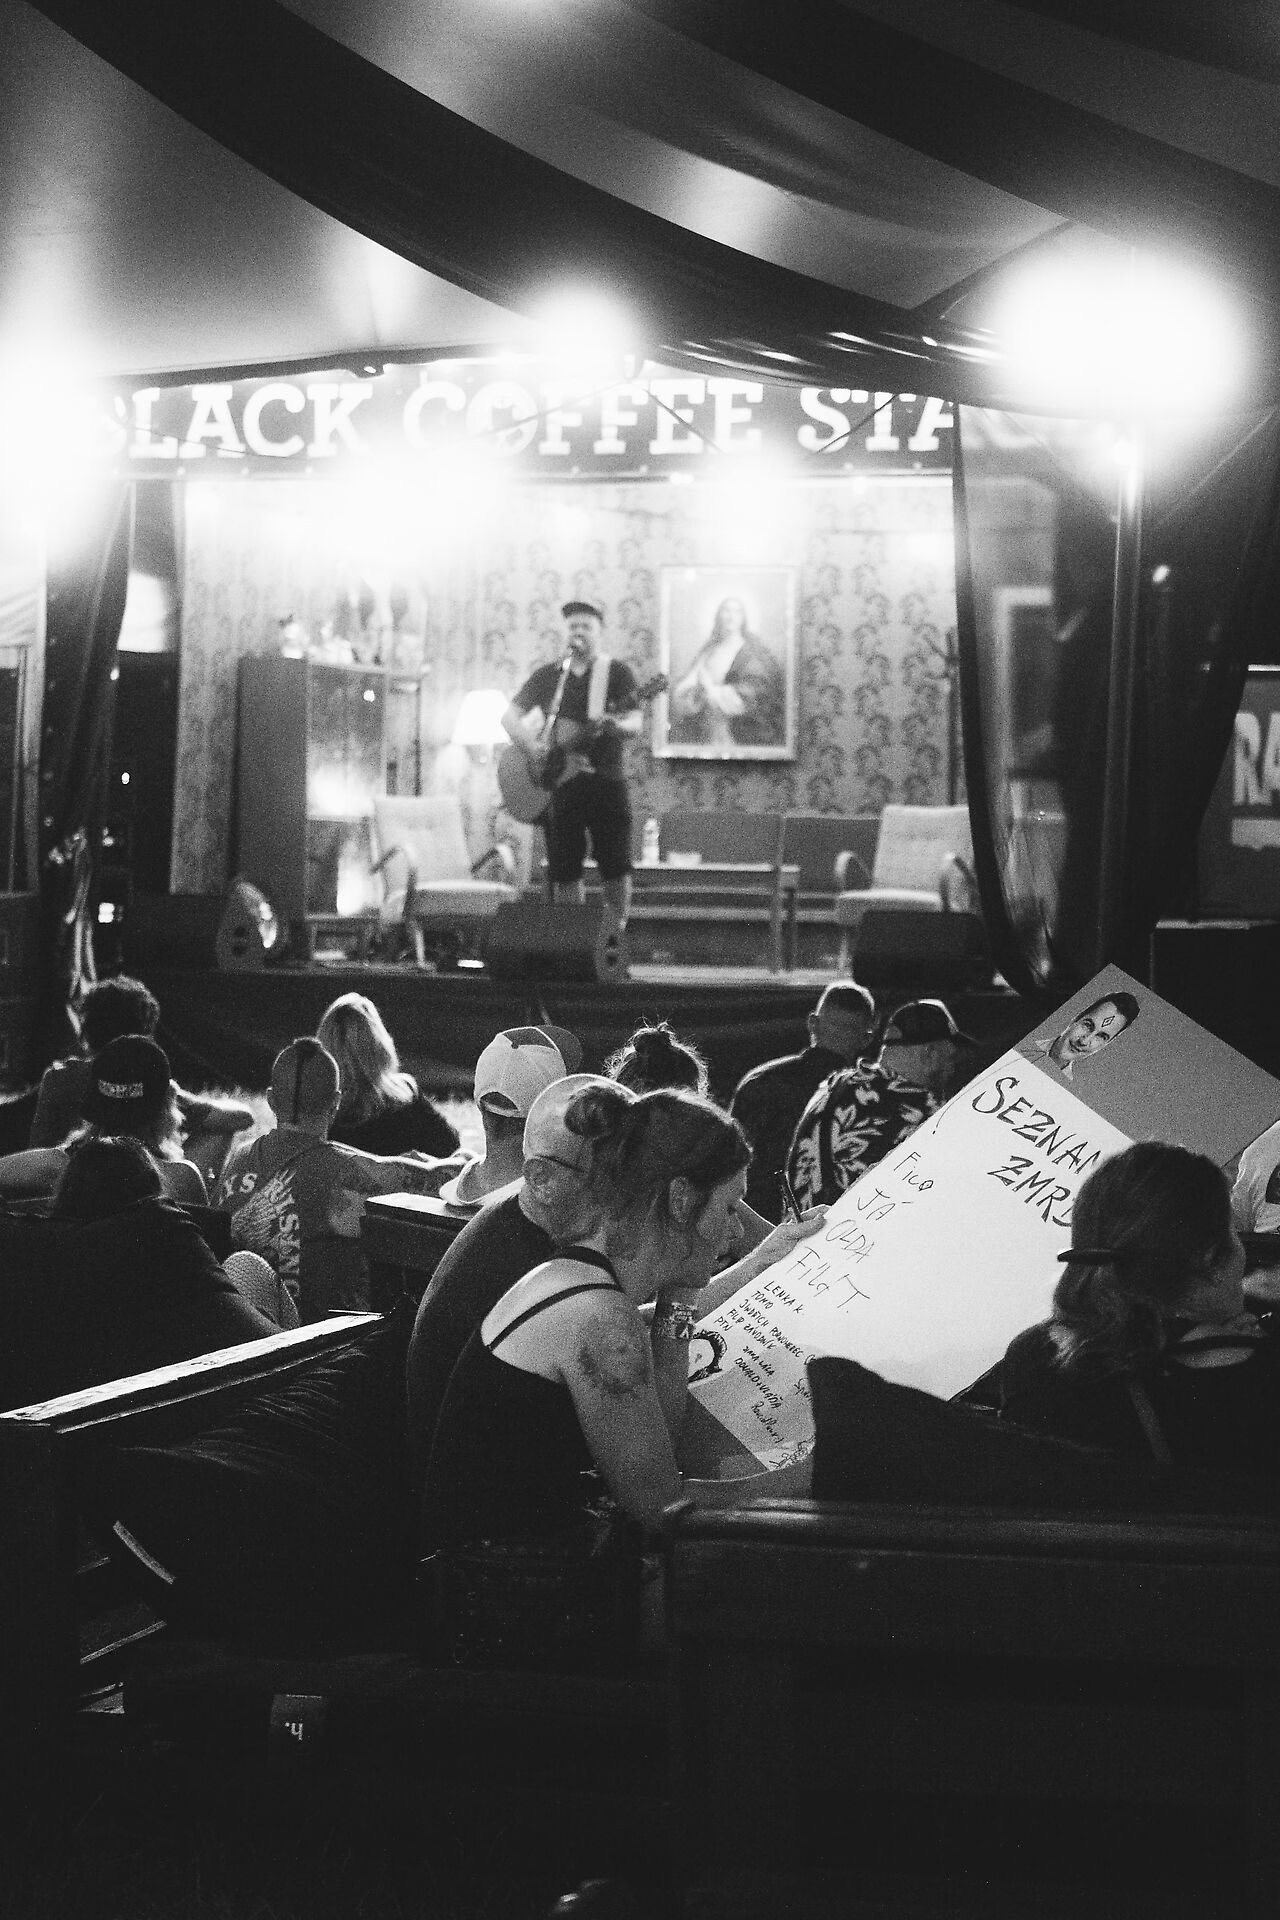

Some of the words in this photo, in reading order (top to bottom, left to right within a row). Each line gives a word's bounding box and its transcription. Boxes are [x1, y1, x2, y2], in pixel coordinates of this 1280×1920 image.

[106, 382, 374, 459] LACK
[402, 377, 764, 455] COFFEE
[825, 1219, 875, 1264] OLDA
[763, 1280, 796, 1306] LENKA
